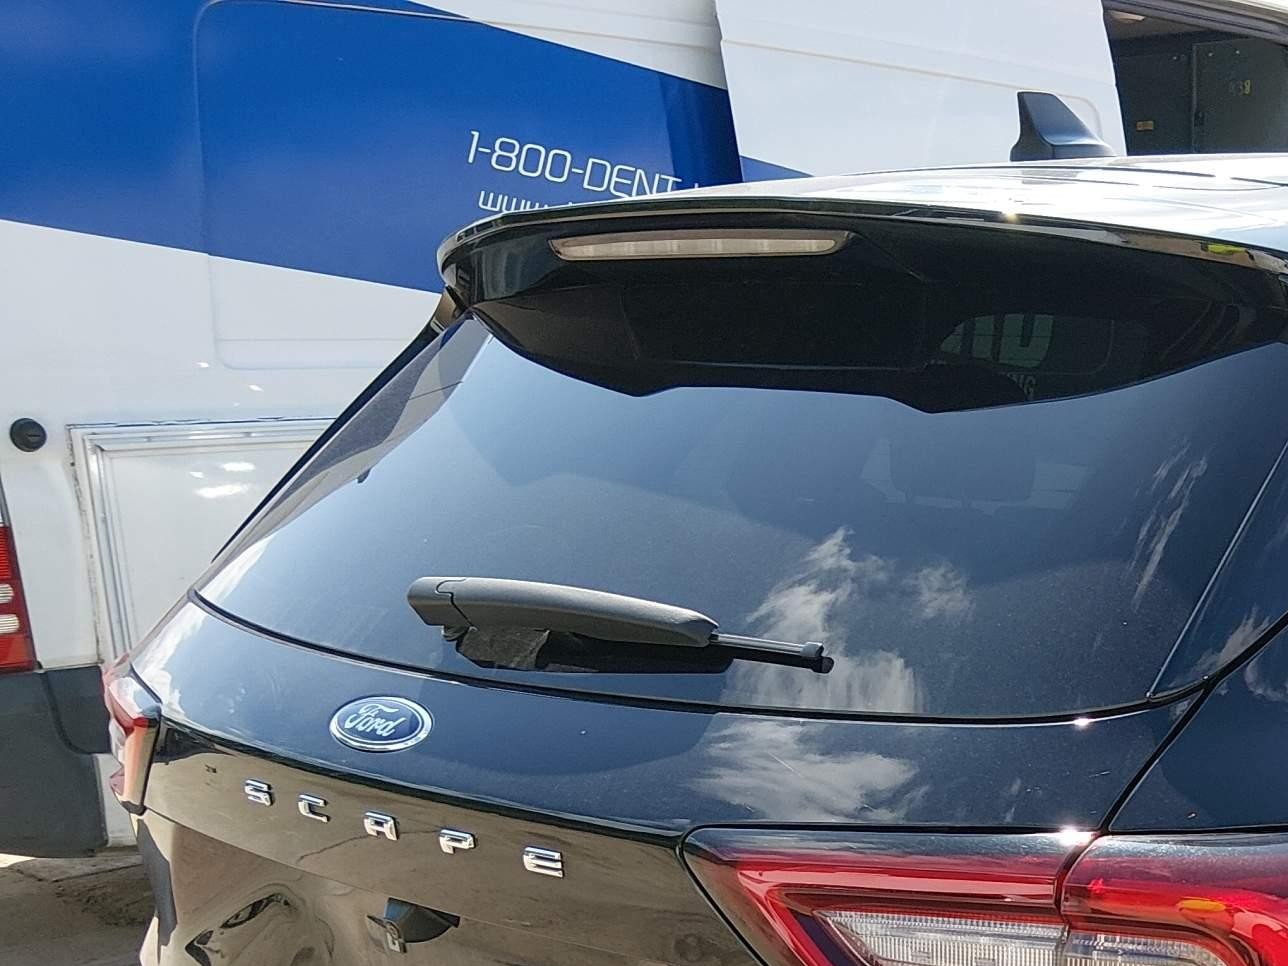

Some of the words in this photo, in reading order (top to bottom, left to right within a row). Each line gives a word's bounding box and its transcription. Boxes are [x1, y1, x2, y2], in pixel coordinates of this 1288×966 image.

[467, 130, 699, 199] 1-800-DENT
[344, 703, 406, 737] Ford
[244, 779, 565, 878] SCAPE
